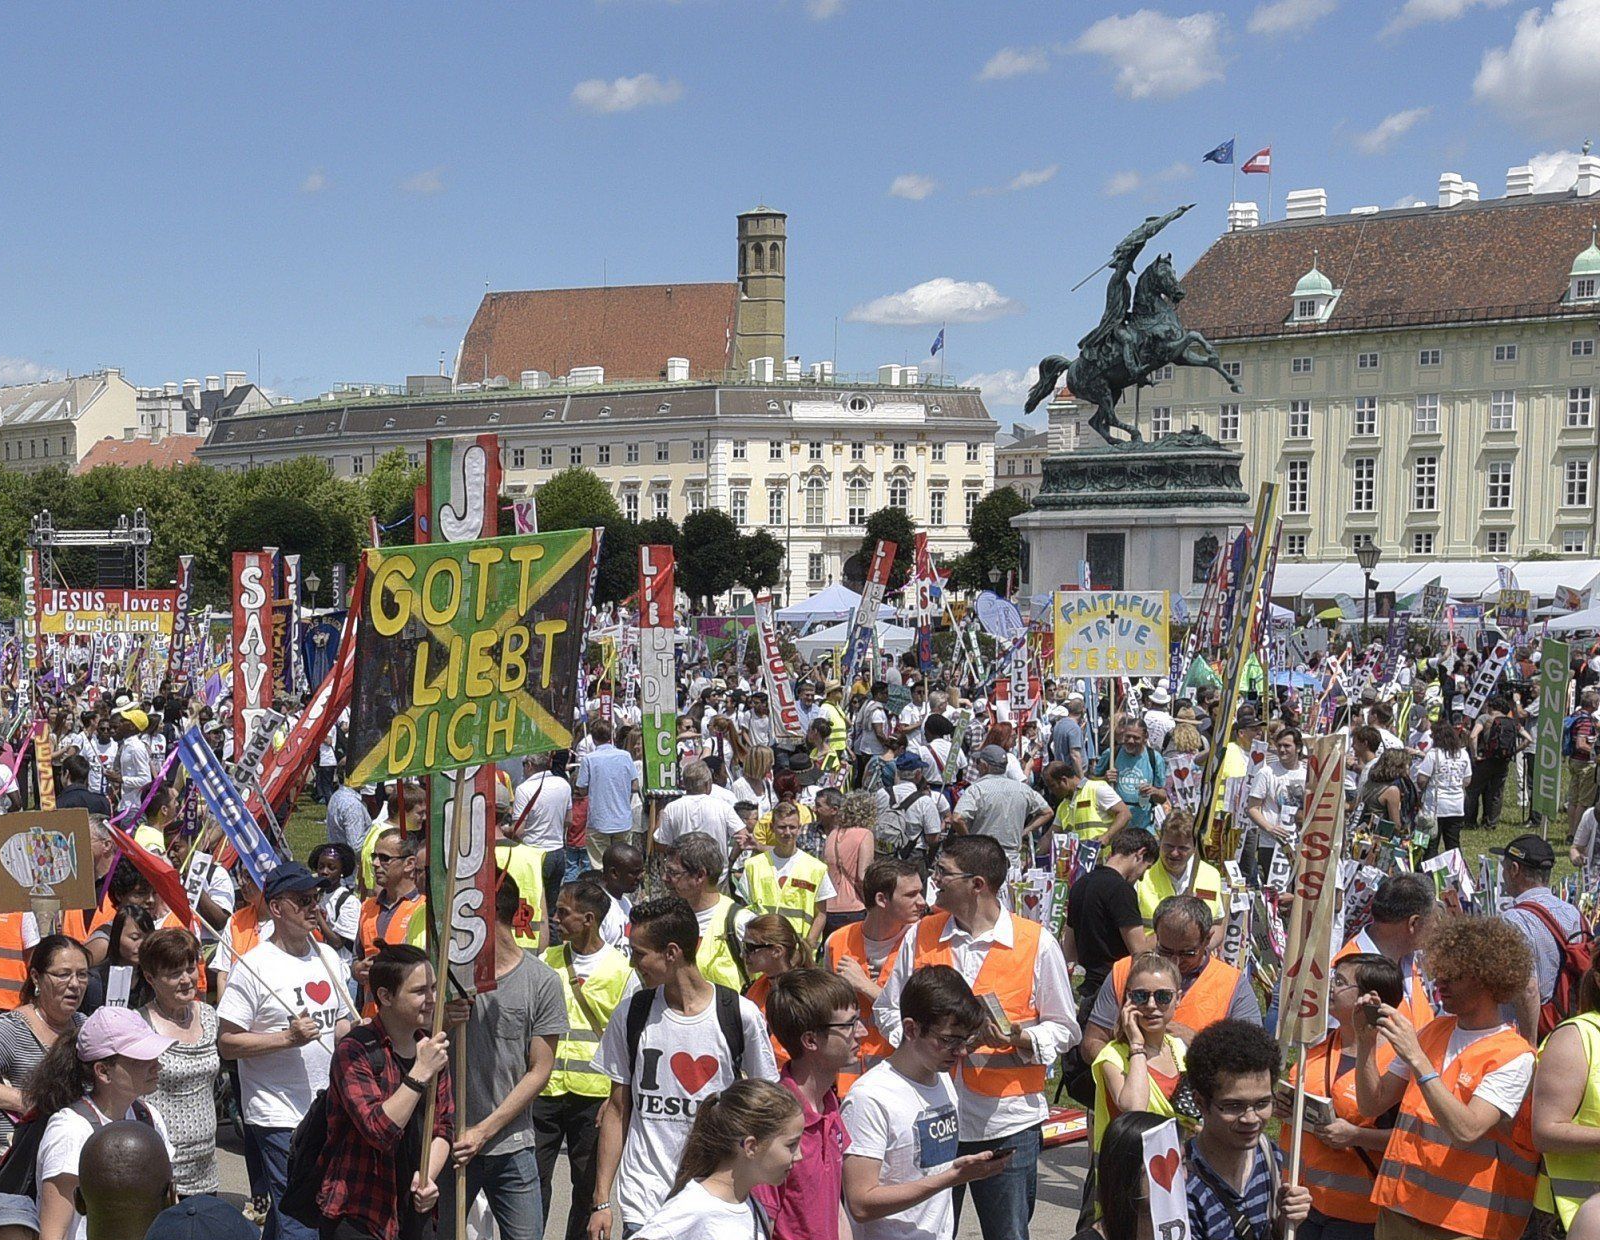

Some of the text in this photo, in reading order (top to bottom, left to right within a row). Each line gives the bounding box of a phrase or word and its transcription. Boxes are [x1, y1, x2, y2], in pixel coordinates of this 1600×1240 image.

[22, 555, 38, 660] JESUS
[44, 590, 172, 616] JESUS loves
[370, 543, 546, 637] GOTT
[1060, 592, 1164, 626] FAITHFUL
[64, 612, 159, 635] Burgenland
[1078, 618, 1151, 645] TRUE
[412, 619, 568, 708] LIEBT
[641, 546, 677, 789] LIEBT DICH
[1067, 647, 1158, 671] JESUS
[1170, 647, 1180, 691] JESUS
[1013, 659, 1027, 706] DICH
[387, 696, 519, 776] DICH
[1539, 657, 1565, 800] GNADE
[929, 1115, 958, 1139] CORE
